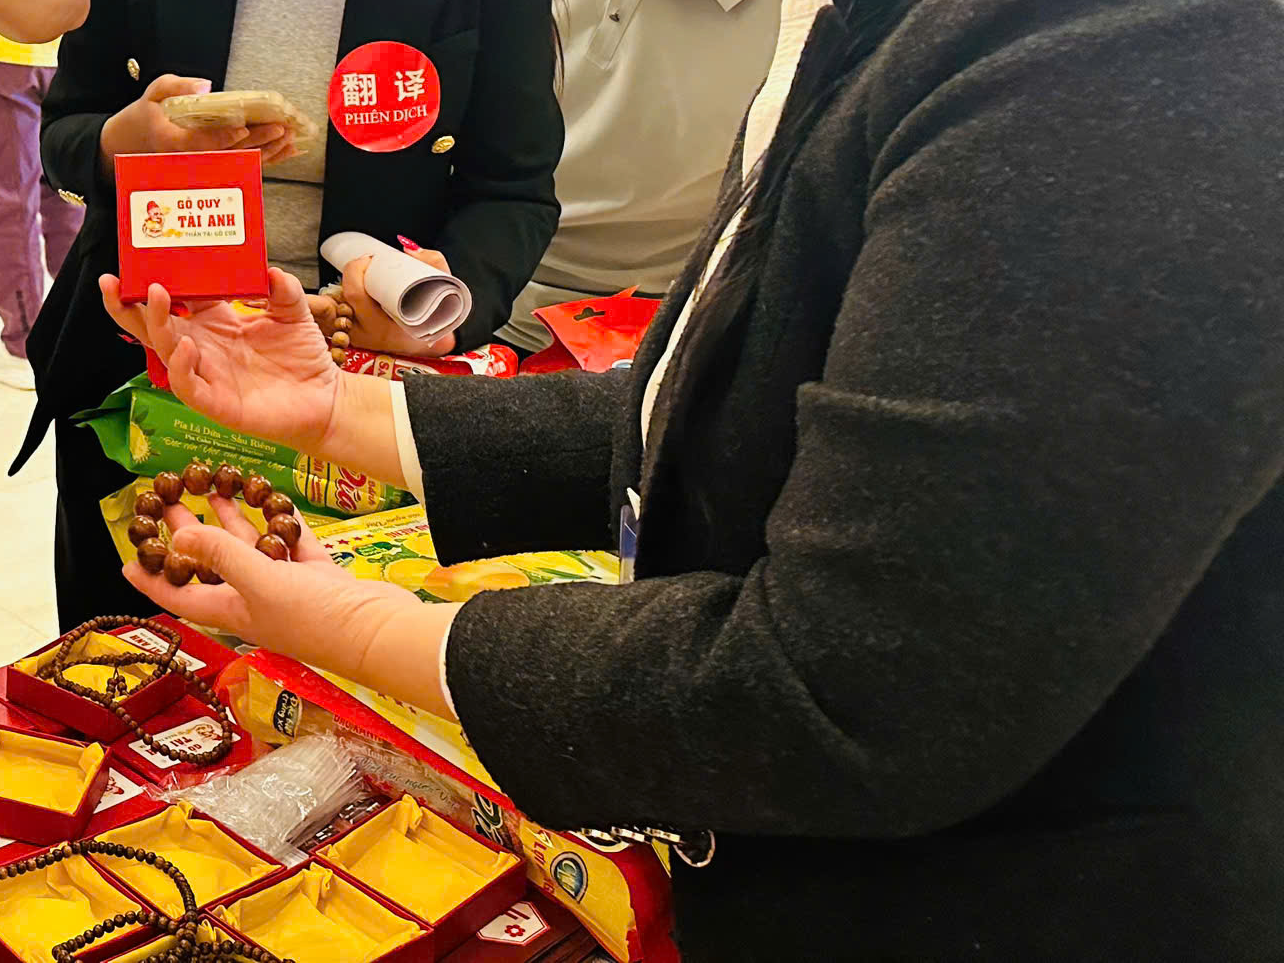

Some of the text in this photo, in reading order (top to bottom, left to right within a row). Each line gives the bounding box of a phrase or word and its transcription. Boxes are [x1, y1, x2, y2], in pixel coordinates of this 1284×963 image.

[342, 68, 425, 107] 翻译
[345, 104, 428, 125] PHIÊN DỊCH
[178, 211, 236, 228] TÀI ANH
